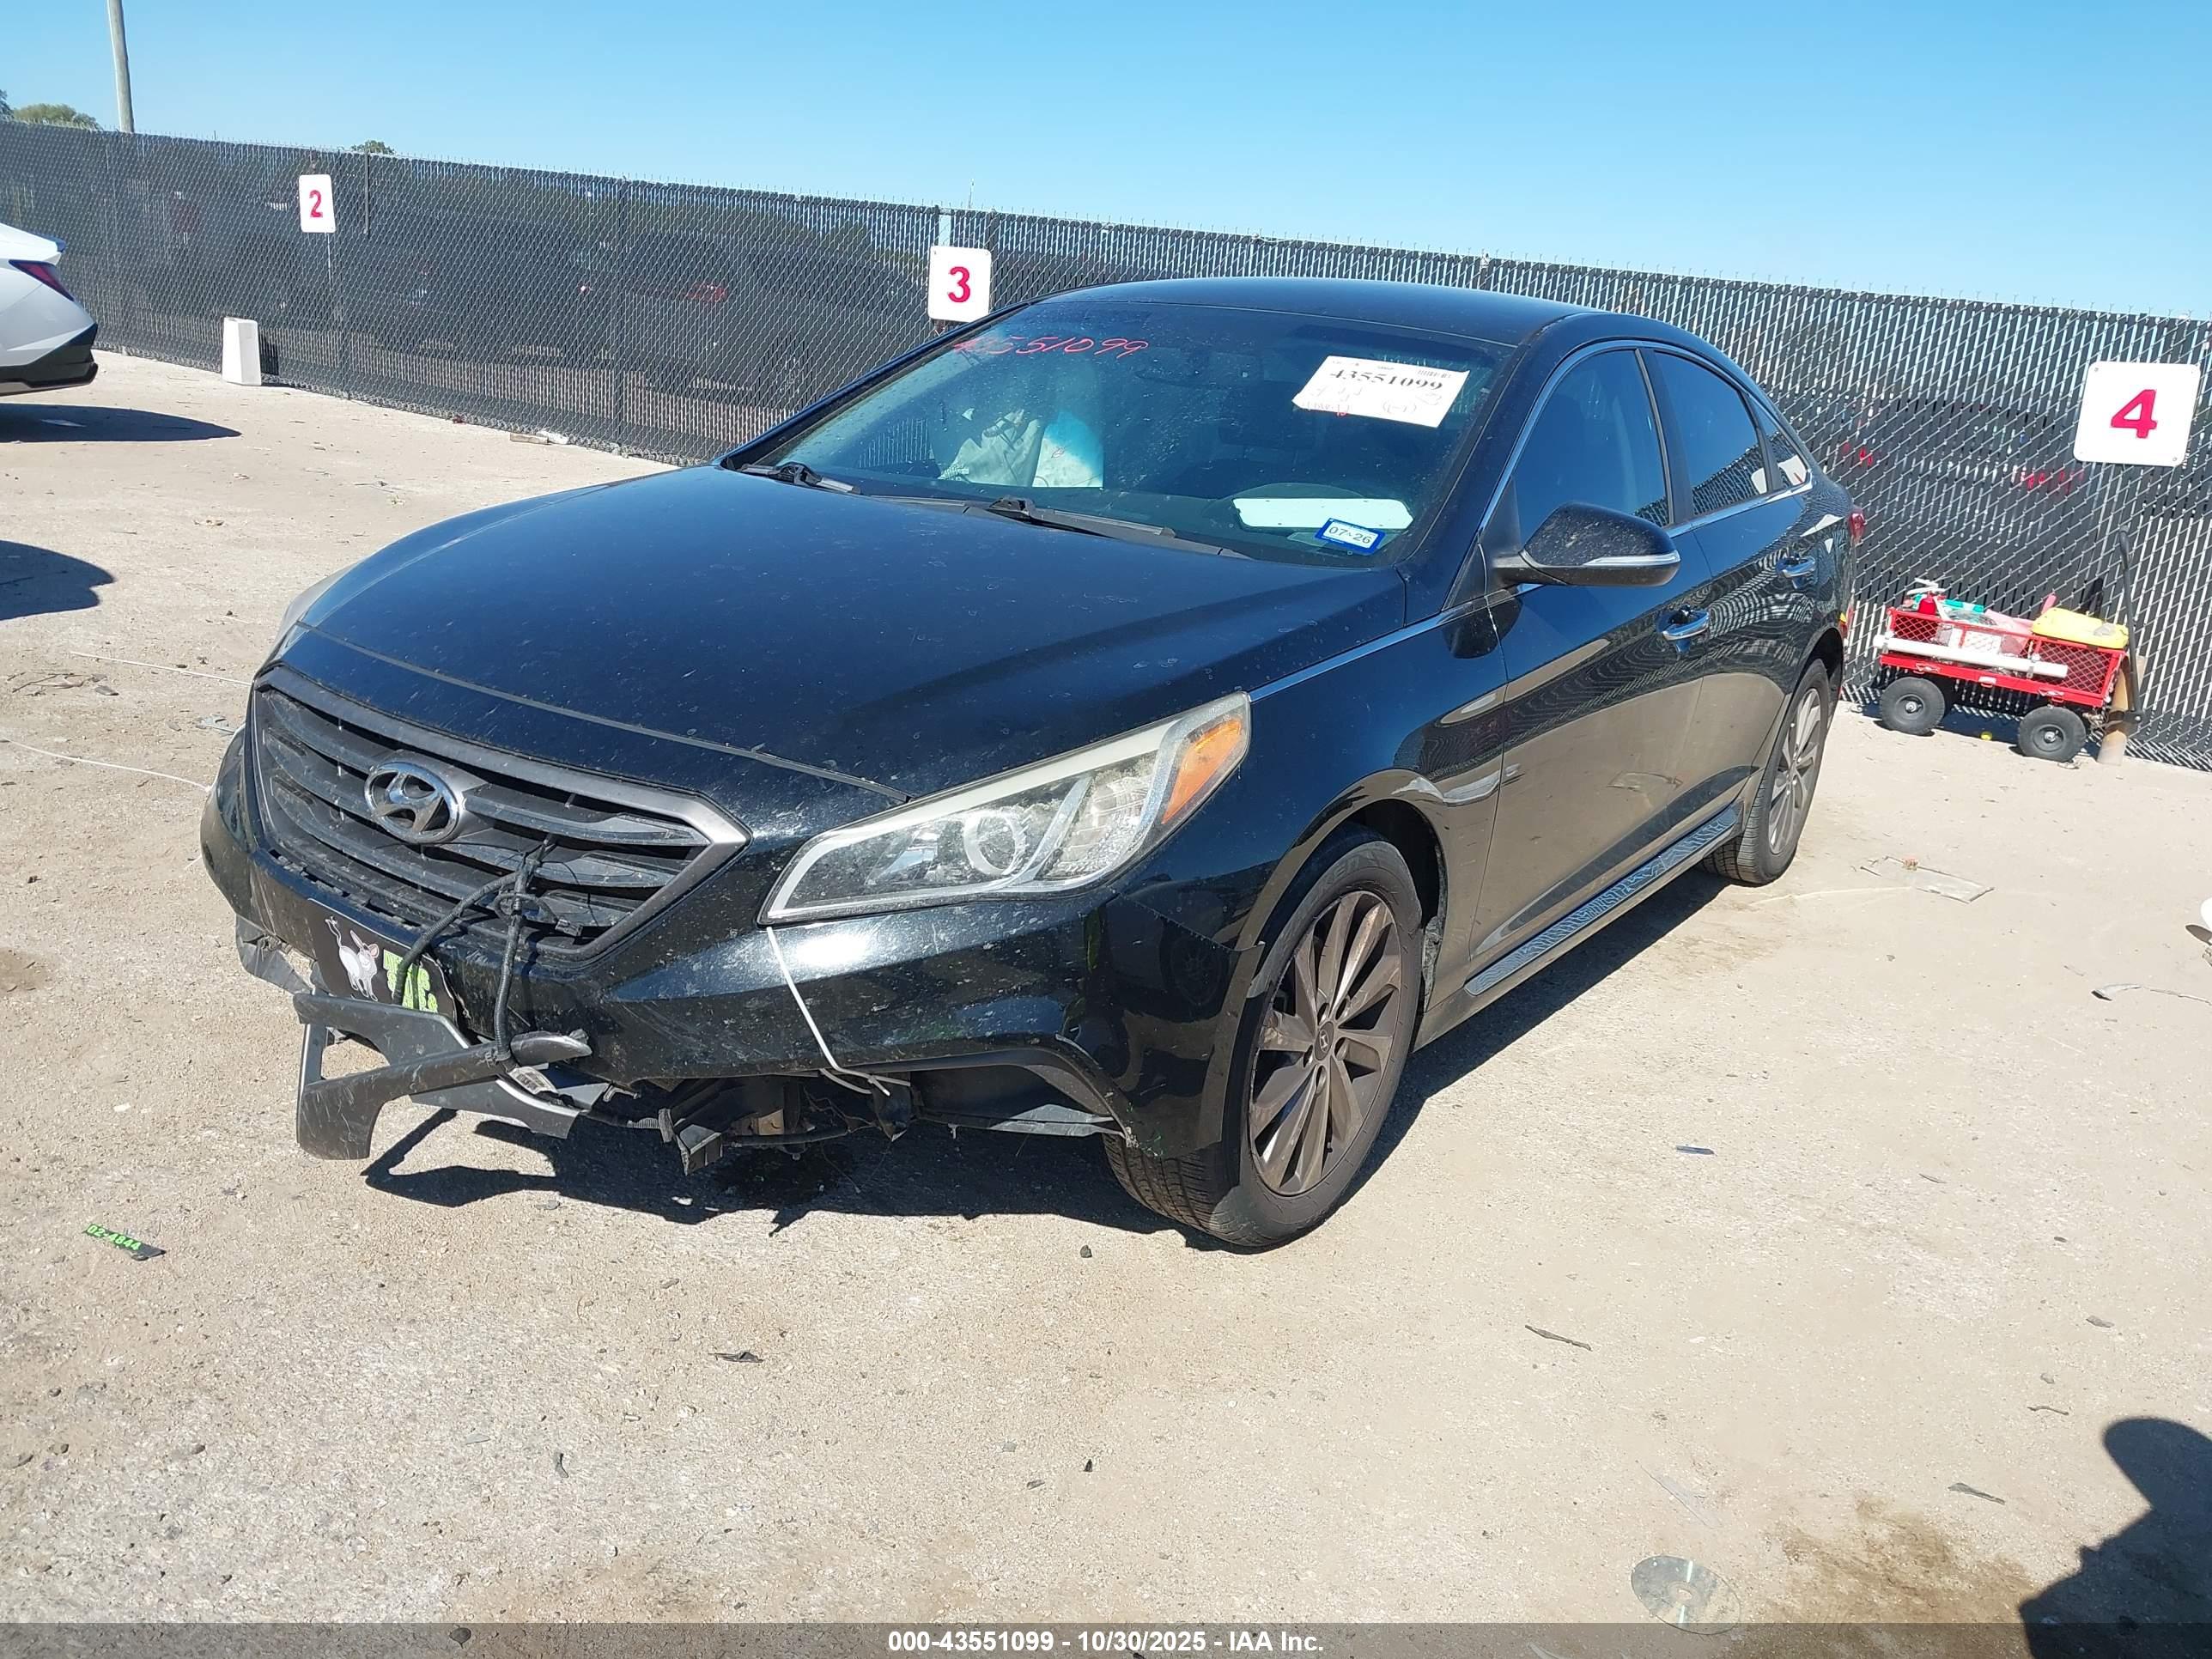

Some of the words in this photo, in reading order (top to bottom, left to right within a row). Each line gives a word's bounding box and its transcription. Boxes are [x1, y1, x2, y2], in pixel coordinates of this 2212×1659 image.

[309, 190, 323, 217] 2
[948, 266, 971, 303] 3
[953, 336, 1149, 359] 551099
[1330, 369, 1443, 390] 43551099
[2111, 389, 2157, 439] 4
